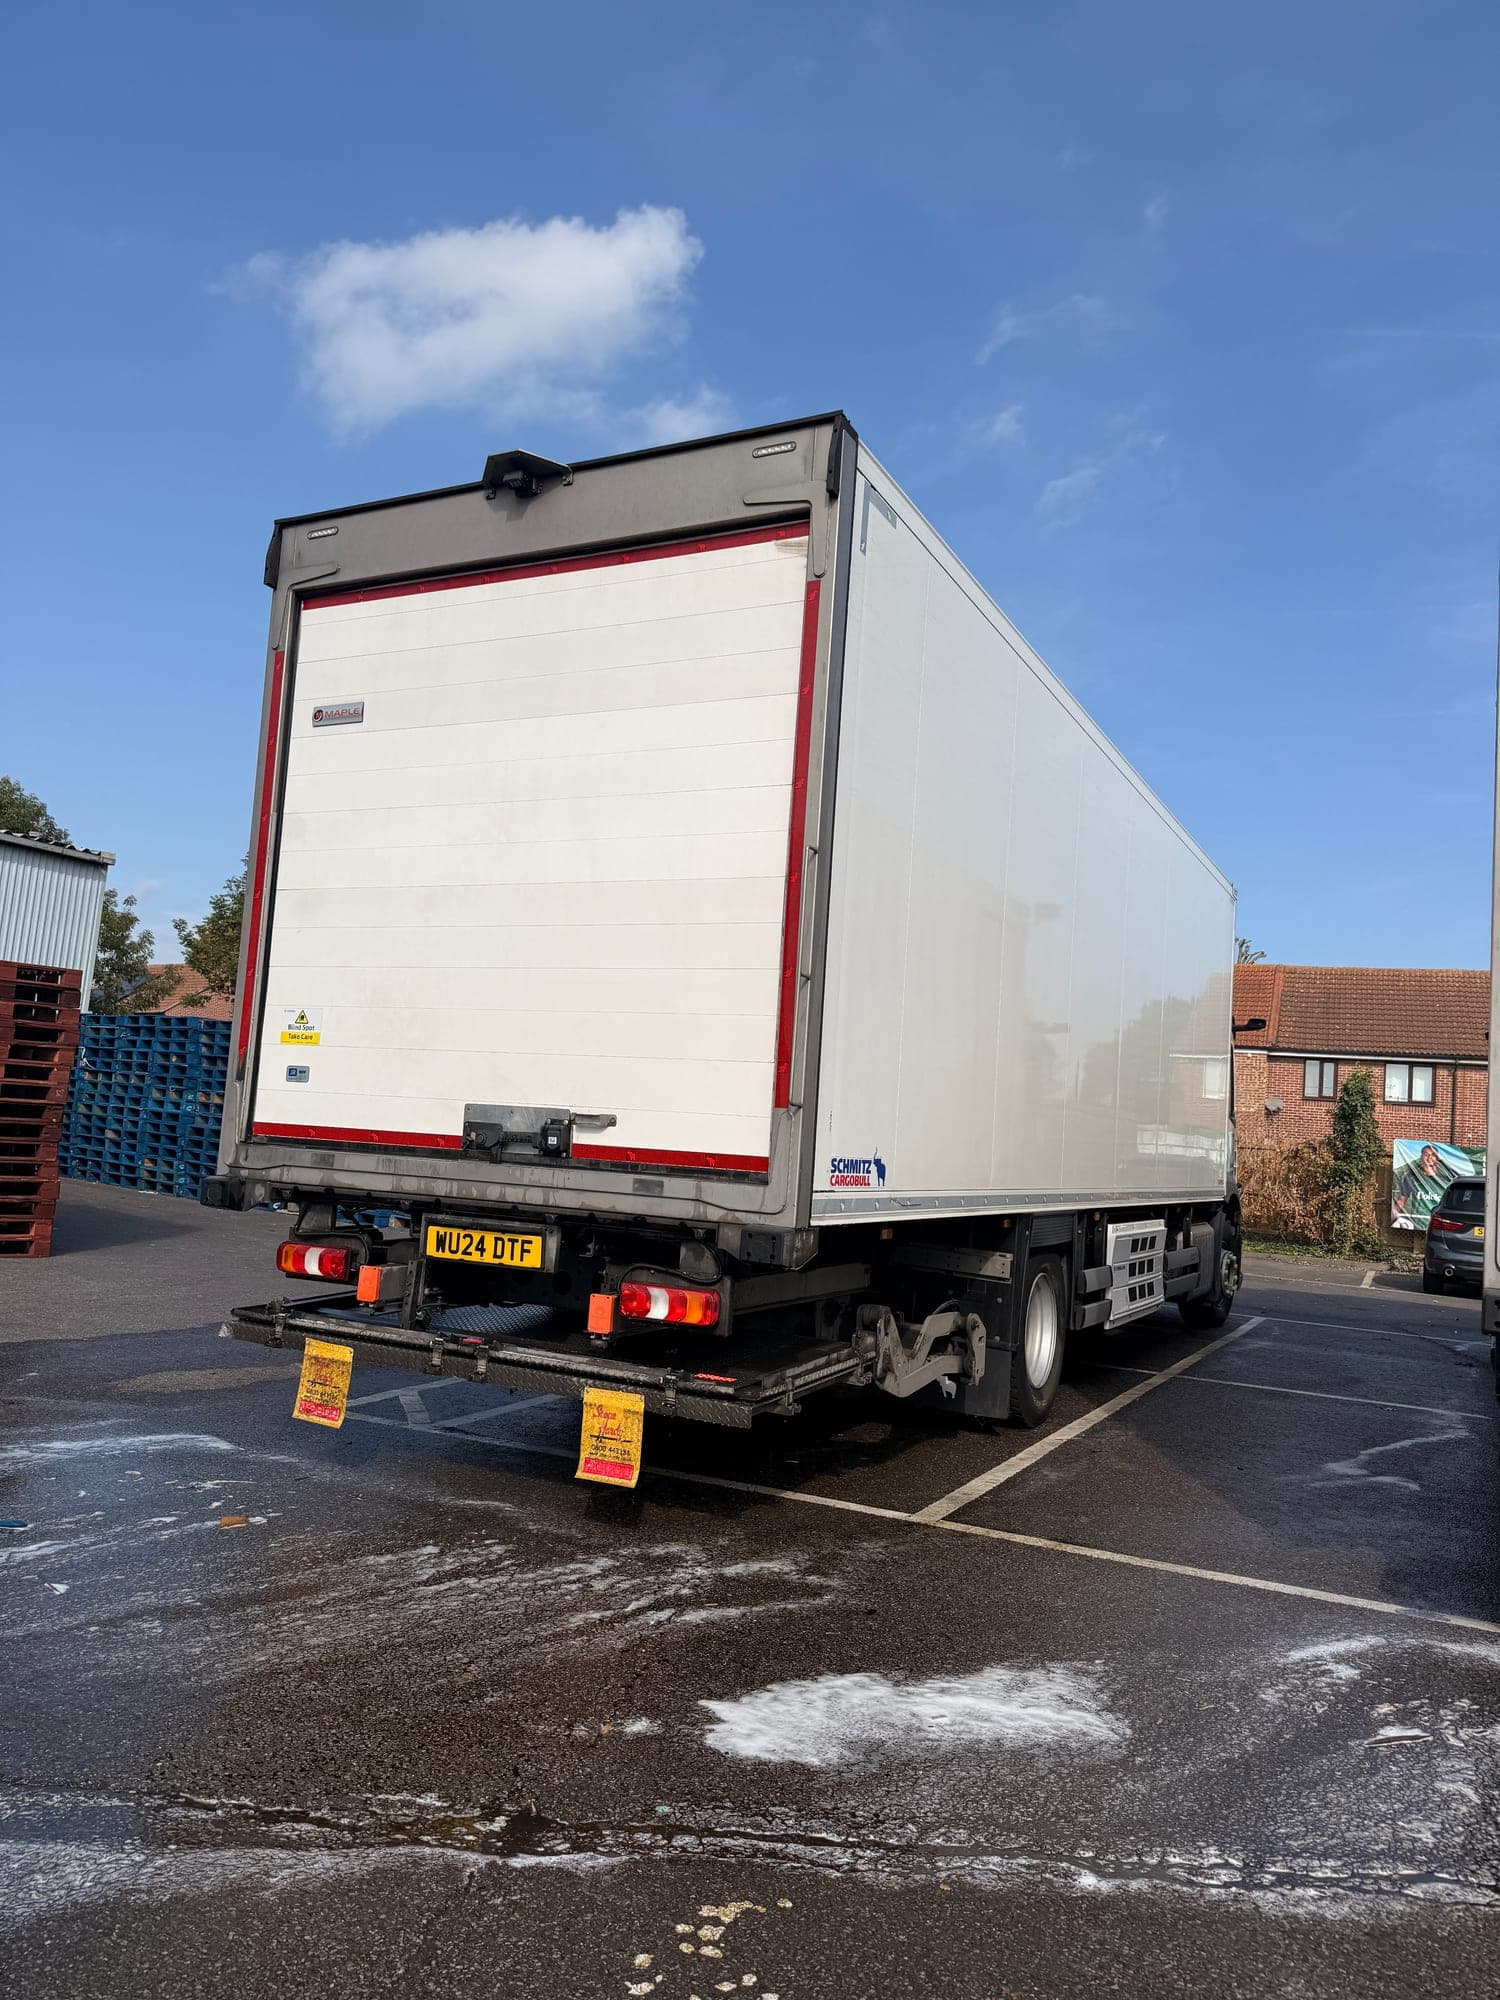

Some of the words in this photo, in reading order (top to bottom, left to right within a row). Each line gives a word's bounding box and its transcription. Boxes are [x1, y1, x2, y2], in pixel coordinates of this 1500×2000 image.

[324, 707, 361, 718] MAPLE
[301, 1033, 313, 1041] Care
[830, 1157, 872, 1175] SCHMITZ
[830, 1174, 871, 1187] CARGOBULL
[435, 1231, 487, 1258] WU24
[492, 1236, 533, 1263] DTF
